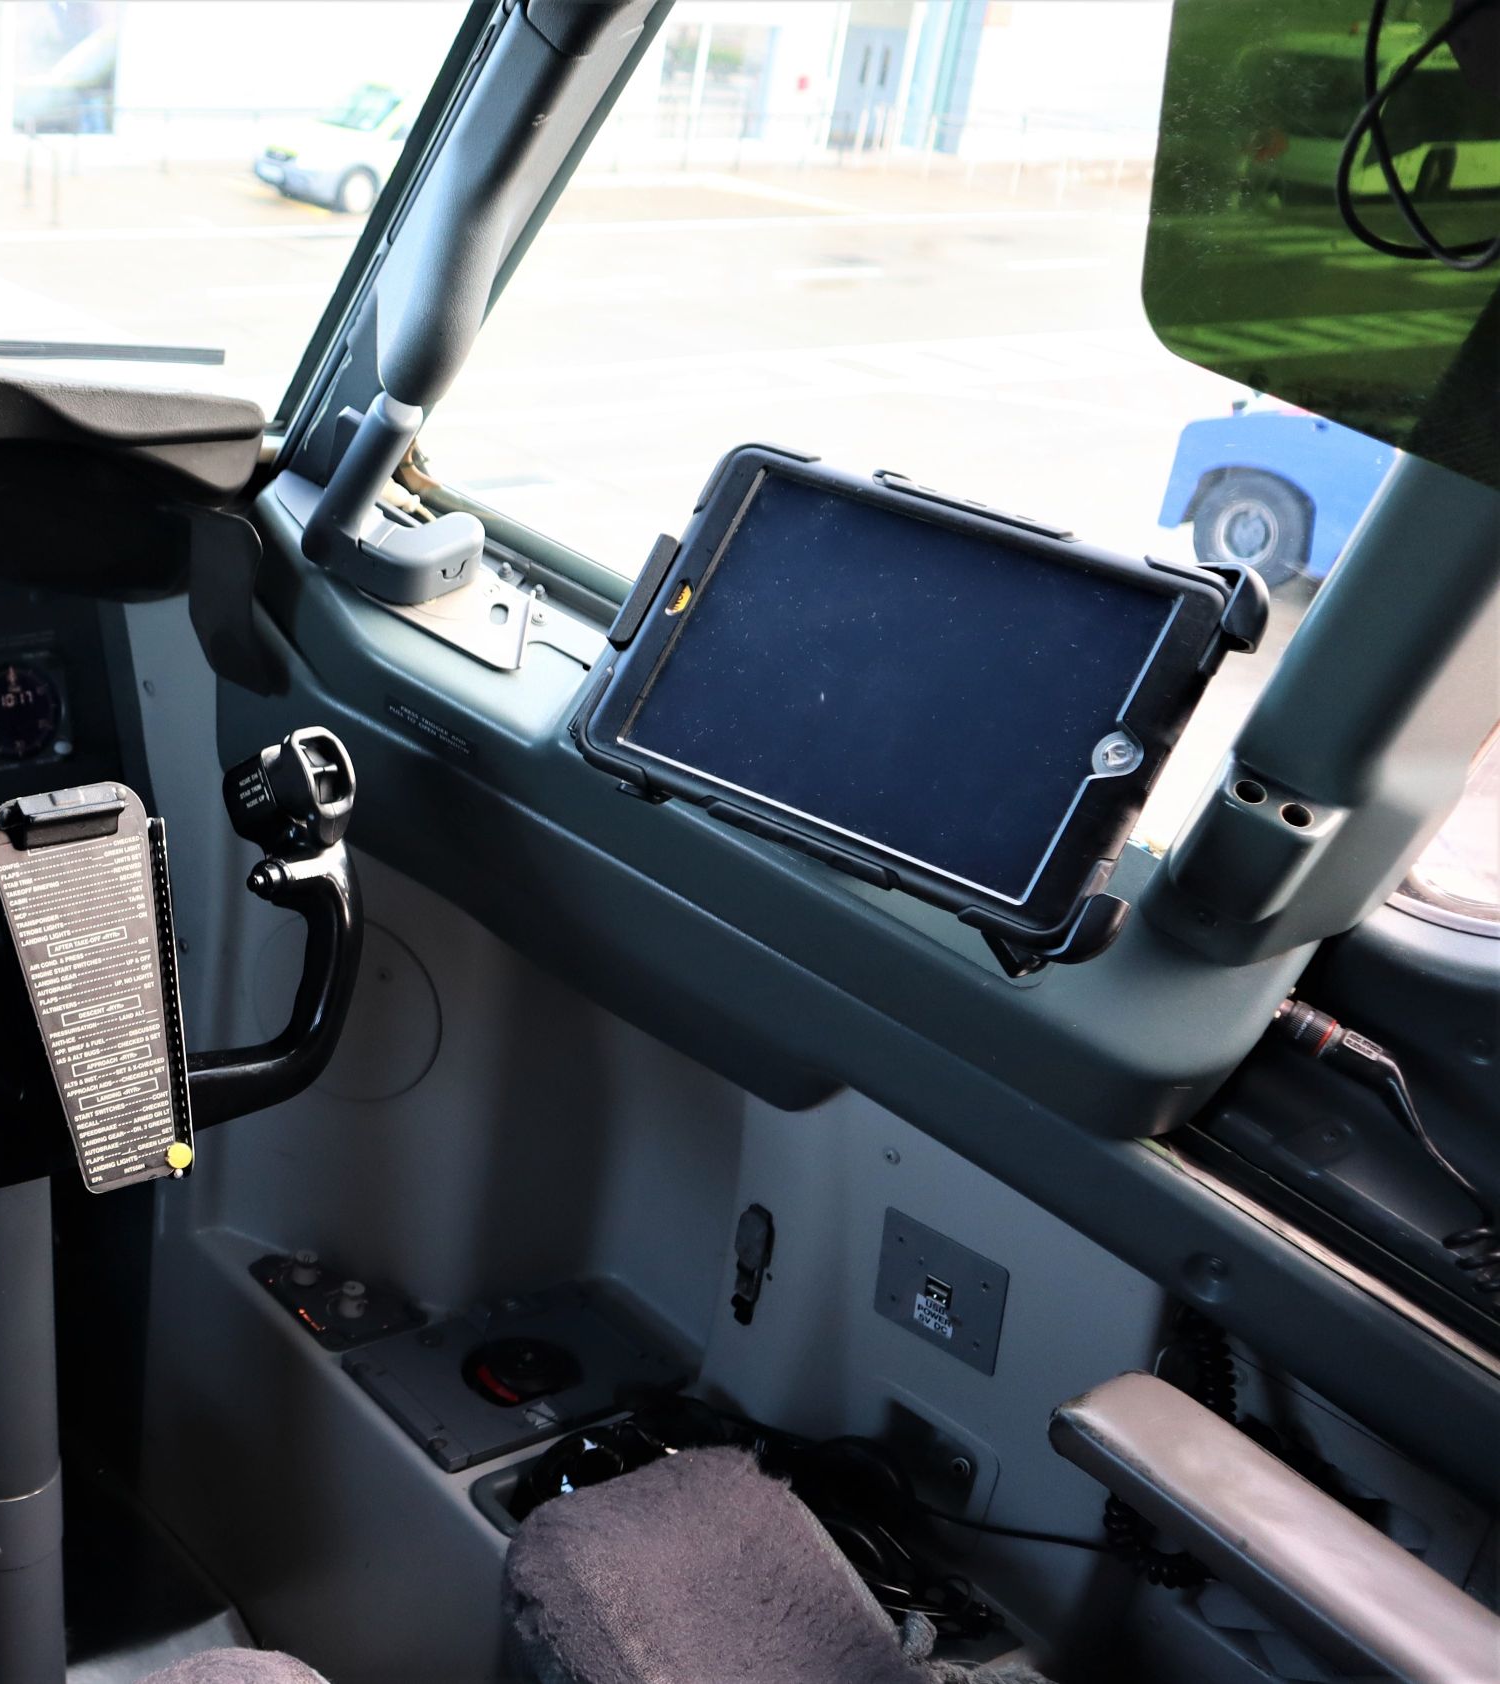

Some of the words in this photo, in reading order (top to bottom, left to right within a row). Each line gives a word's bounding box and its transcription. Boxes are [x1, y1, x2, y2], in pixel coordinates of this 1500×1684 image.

[401, 705, 419, 720] PRESS
[422, 717, 449, 736] TRIGGER
[451, 734, 467, 746] AND
[419, 721, 437, 736] OPEN
[440, 733, 470, 755] WINDOW
[113, 835, 139, 846] CHECKED
[104, 848, 124, 857] GREEN
[124, 844, 140, 852] LIGHT
[113, 862, 142, 873] REVIEWED
[114, 856, 131, 864] UNITS
[1, 872, 20, 880] FLAPS
[3, 881, 19, 890] STAB
[19, 878, 33, 886] TRIM
[119, 871, 142, 881] SECURE
[6, 887, 32, 898] TAKEOFF
[33, 881, 60, 892] BRIEFING
[9, 898, 28, 906] CABIN
[14, 912, 27, 920] MCP
[16, 914, 59, 929] TRANSPONDER
[19, 927, 43, 938] STROBE
[43, 922, 64, 932] LIGHTS
[21, 935, 48, 947] LANDING
[49, 930, 71, 940] LIGHTS
[54, 943, 74, 952] AFTER
[74, 936, 101, 946] TAKE-OFF
[64, 953, 84, 962] PRESS
[31, 970, 53, 980] ENGINE
[53, 965, 72, 975] START
[73, 958, 102, 970] SWITCHES
[34, 977, 60, 989] LANDING
[60, 973, 77, 982] GEAR
[40, 997, 58, 1006] FLAPS
[133, 972, 153, 982] LIGHTS
[37, 983, 73, 997] AUTOBRAKE
[42, 1002, 77, 1015] ALTIMETERS
[78, 1007, 105, 1019] DESCENT
[49, 1022, 97, 1039] PRESSURISATION
[119, 1013, 134, 1021] LAND
[52, 1036, 76, 1048] ANTI-ICE
[68, 1043, 84, 1053] BRIEF
[90, 1038, 105, 1047] FUEL
[129, 1023, 160, 1037] DISCUSSED
[73, 1053, 83, 1061] ALT
[84, 1048, 100, 1058] BUGS
[118, 1036, 144, 1048] CHECKED
[87, 1057, 118, 1070] APPROACH
[64, 1081, 78, 1089] ALTS
[133, 1057, 165, 1070] X-CHECKED
[67, 1084, 98, 1098] APPROACH
[99, 1081, 112, 1089] AIDS
[121, 1071, 148, 1082] CHECKED
[97, 1091, 122, 1103] LANDING
[74, 1112, 93, 1122] START
[94, 1103, 126, 1116] SWITCHES
[152, 1091, 168, 1100] CONT
[76, 1120, 100, 1130] RECALL
[142, 1100, 169, 1112] CHECKED
[79, 1124, 117, 1139] SPEEDBRAKE
[134, 1114, 153, 1124] ARMED
[82, 1136, 107, 1148] LANDING
[108, 1131, 124, 1140] GEAR
[148, 1117, 171, 1128] GREENS
[84, 1142, 119, 1157] AUTOBRAKE
[86, 1155, 105, 1165] FLAPS
[138, 1140, 157, 1151] GREEN
[158, 1136, 174, 1144] LIGHT
[89, 1162, 116, 1174] LANDING
[116, 1155, 138, 1166] LIGHTS
[917, 1303, 950, 1327] POWER
[925, 1299, 945, 1315] USB
[919, 1313, 931, 1324] 5V
[933, 1321, 948, 1334] DC
